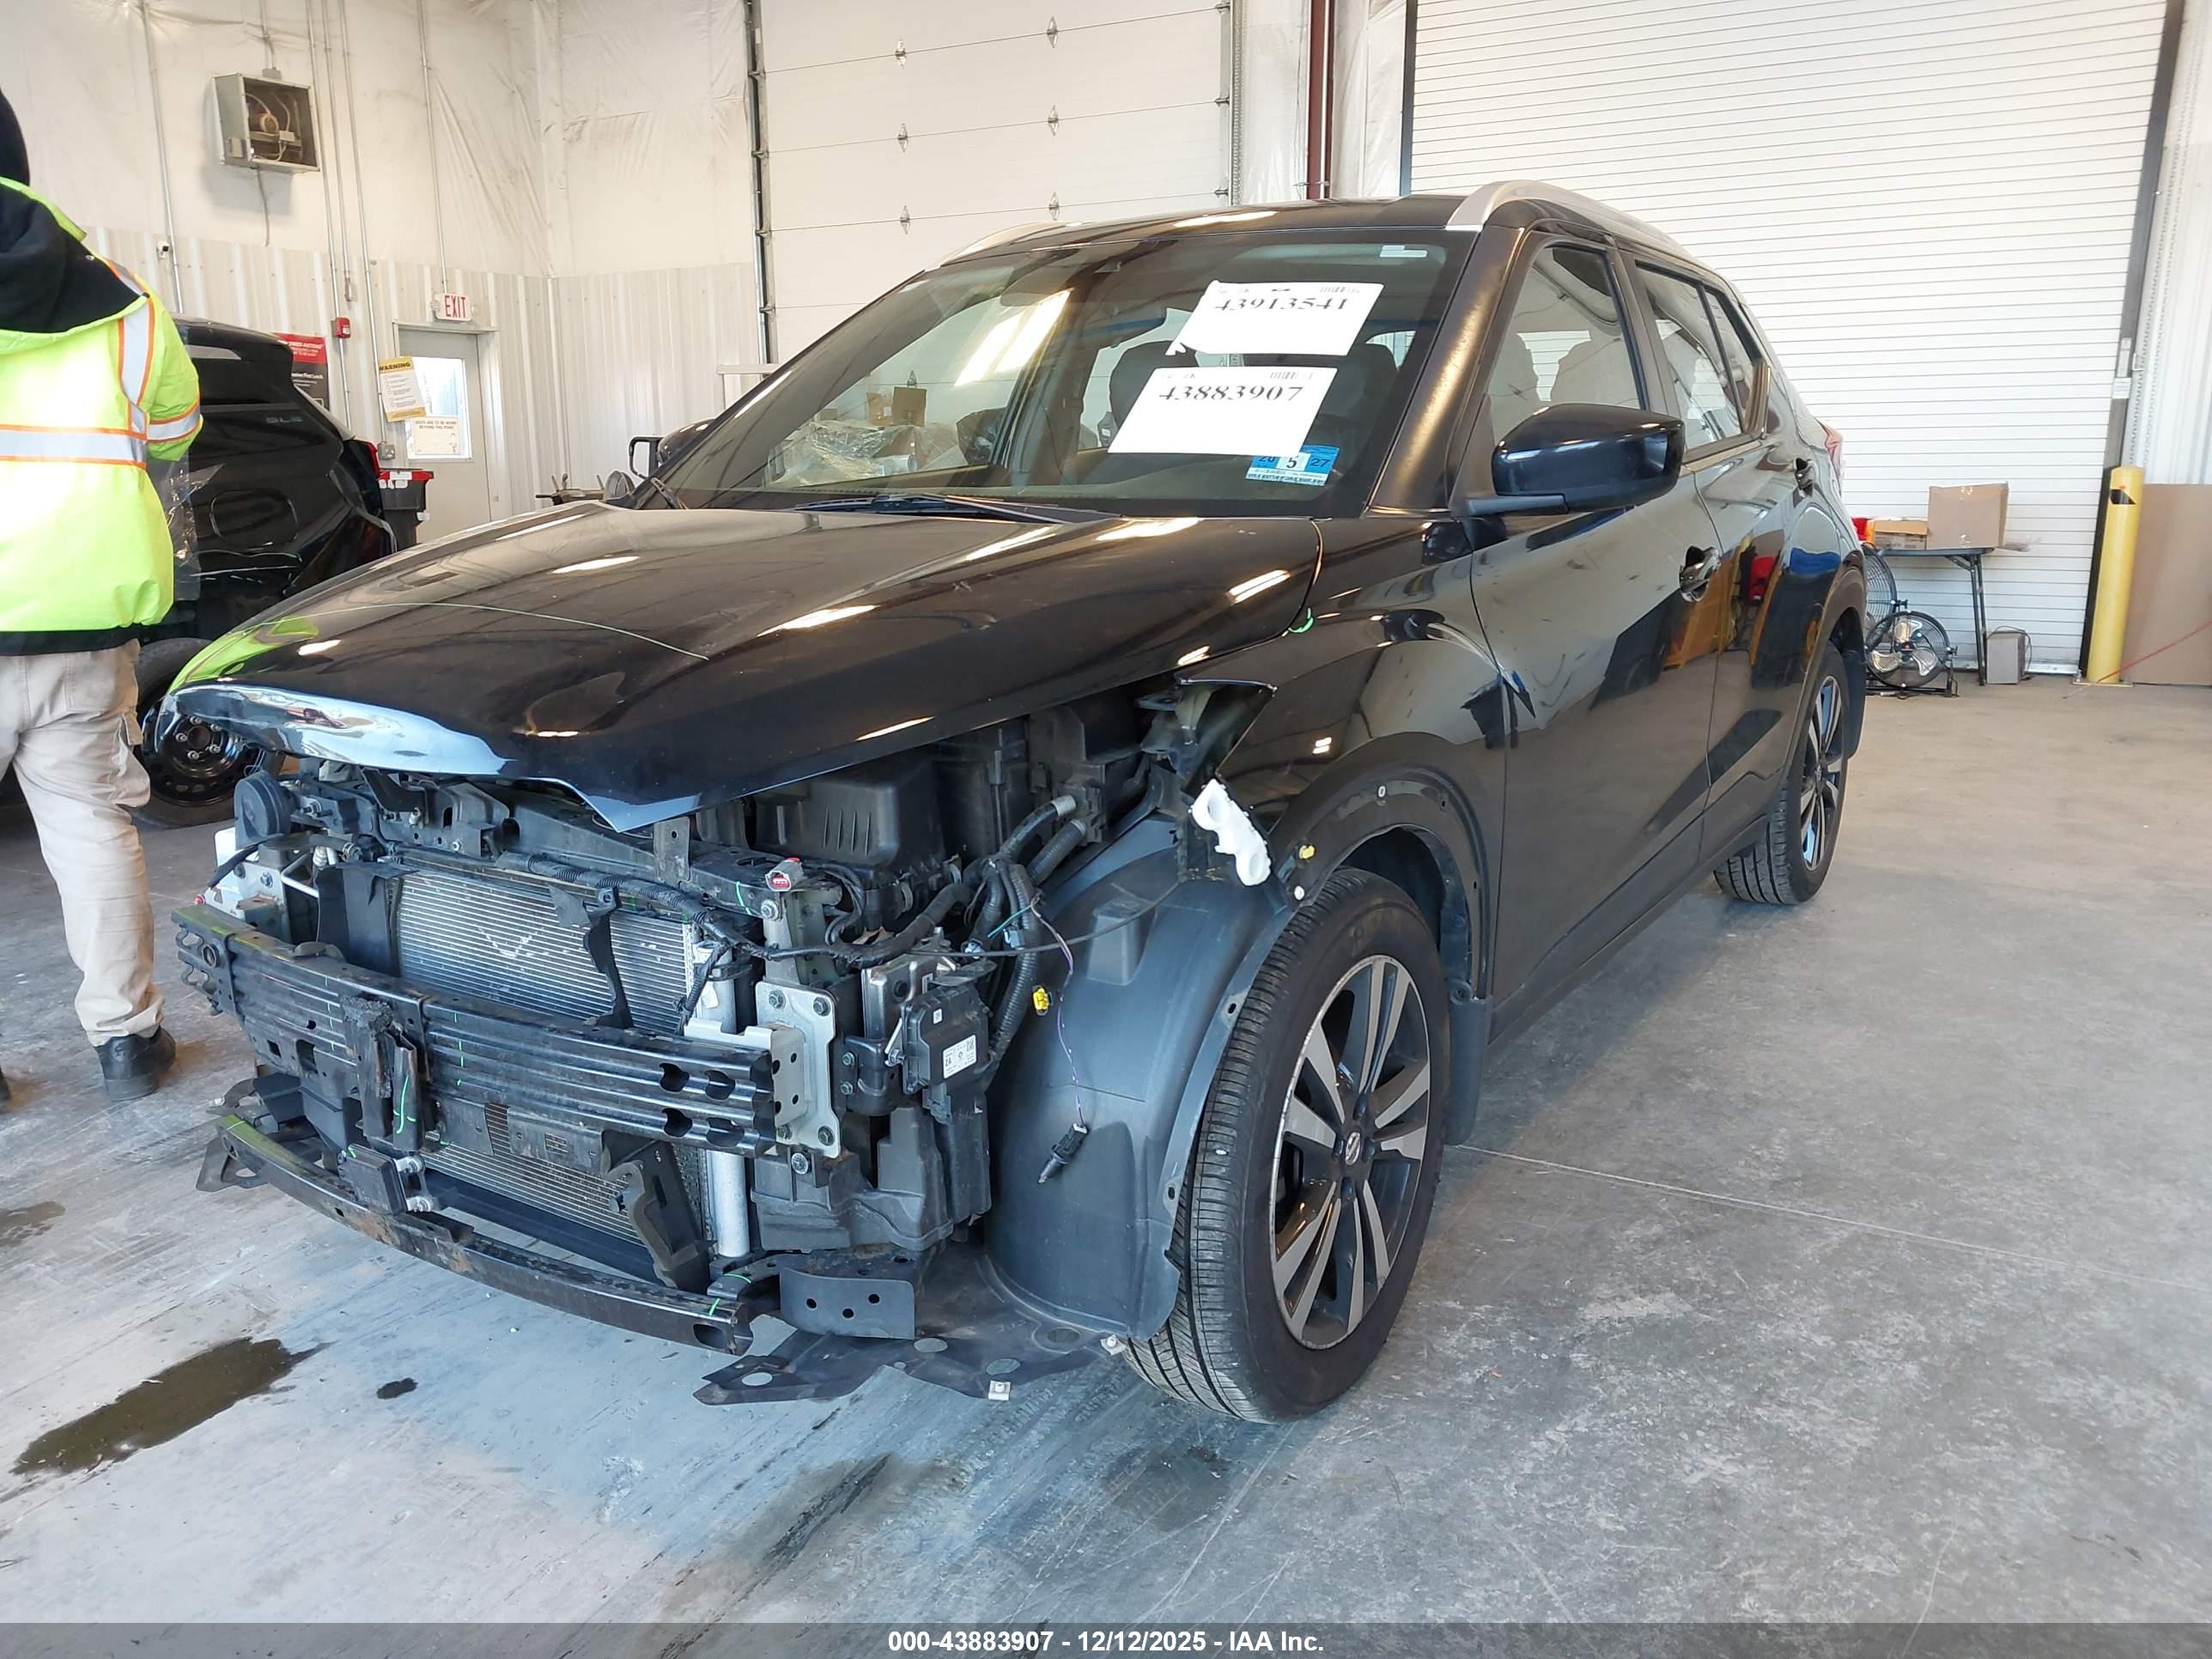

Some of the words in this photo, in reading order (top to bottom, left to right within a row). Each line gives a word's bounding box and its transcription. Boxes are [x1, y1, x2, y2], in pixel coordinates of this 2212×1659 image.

[444, 295, 466, 319] EXIT
[1215, 297, 1348, 311] 43913541
[379, 362, 411, 372] WARNING
[1158, 385, 1304, 401] 43883907
[1286, 455, 1299, 469] 5
[1310, 458, 1330, 468] 27
